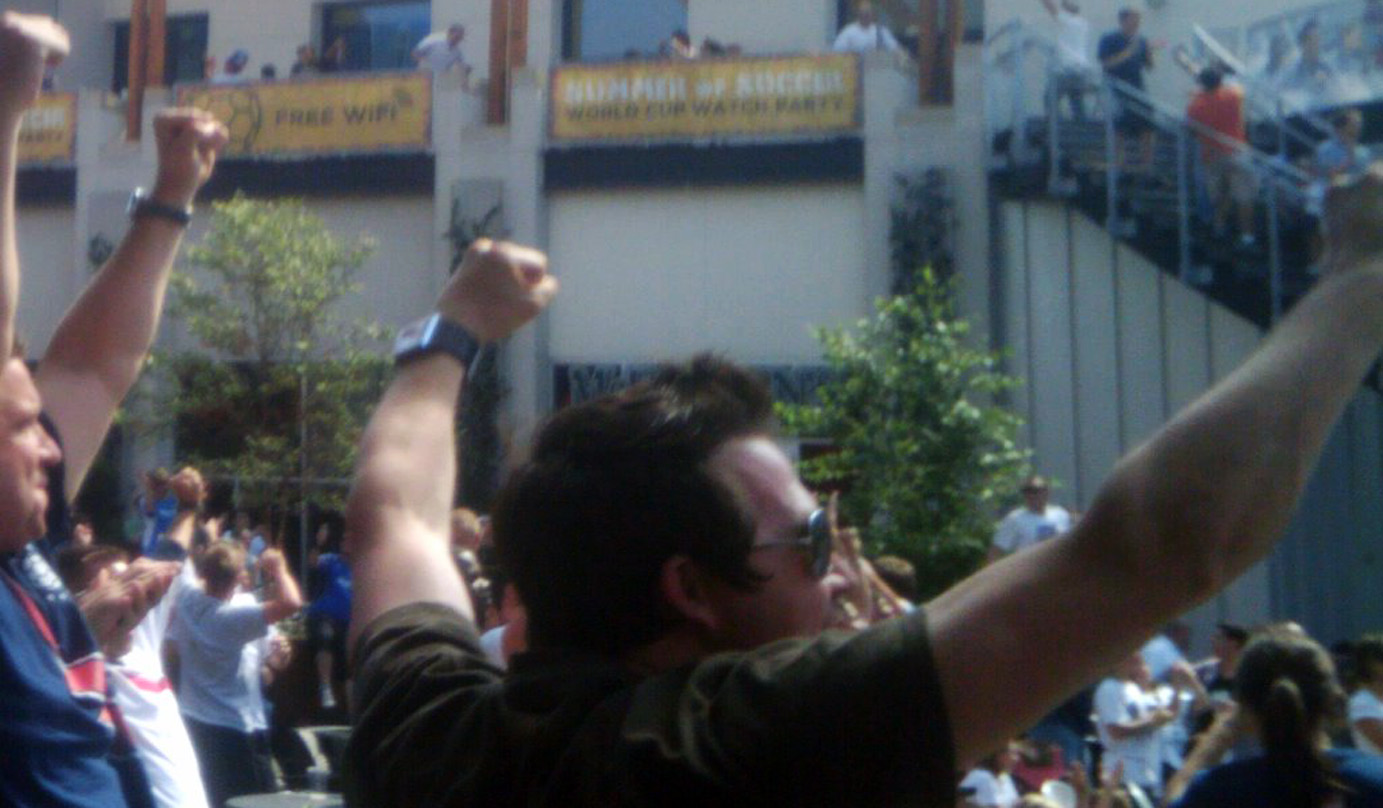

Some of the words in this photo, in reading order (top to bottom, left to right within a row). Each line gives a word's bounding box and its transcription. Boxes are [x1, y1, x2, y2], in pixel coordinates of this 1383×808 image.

[275, 106, 333, 126] FREE
[567, 103, 640, 120] WORLD
[646, 101, 686, 118] CUP
[692, 99, 766, 117] WATCH
[775, 96, 845, 113] PARTY
